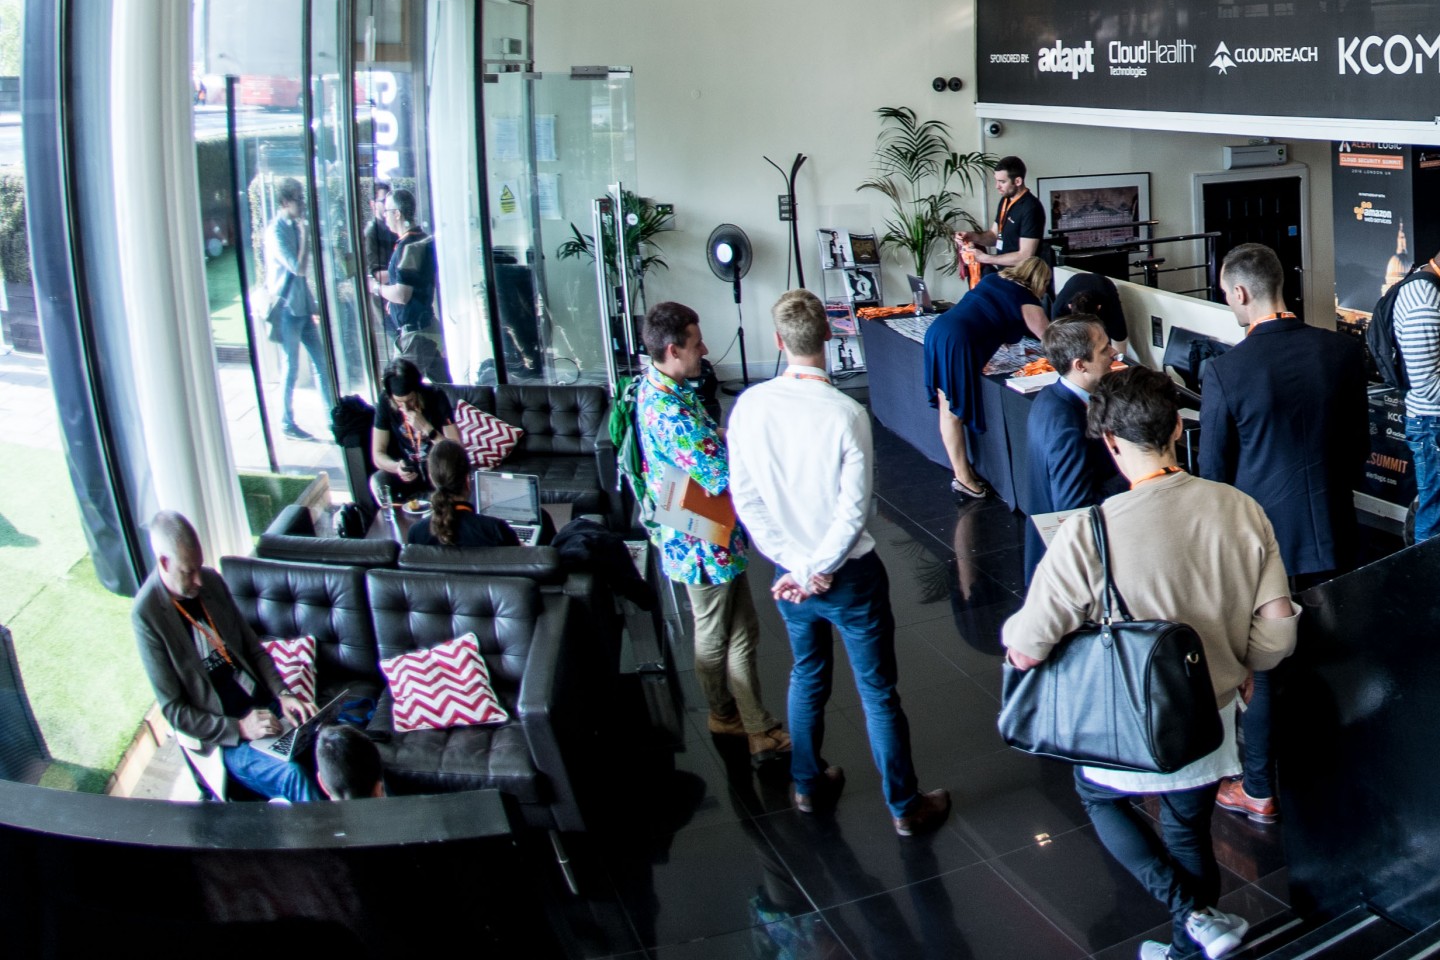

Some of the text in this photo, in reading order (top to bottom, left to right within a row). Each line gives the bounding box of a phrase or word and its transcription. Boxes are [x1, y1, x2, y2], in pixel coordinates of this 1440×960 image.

[1038, 40, 1095, 79] adapt
[1108, 39, 1195, 64] CloudHealth
[1234, 46, 1318, 64] CLOUDREACH
[1109, 66, 1147, 77] Technologies
[1364, 208, 1392, 218] amazon
